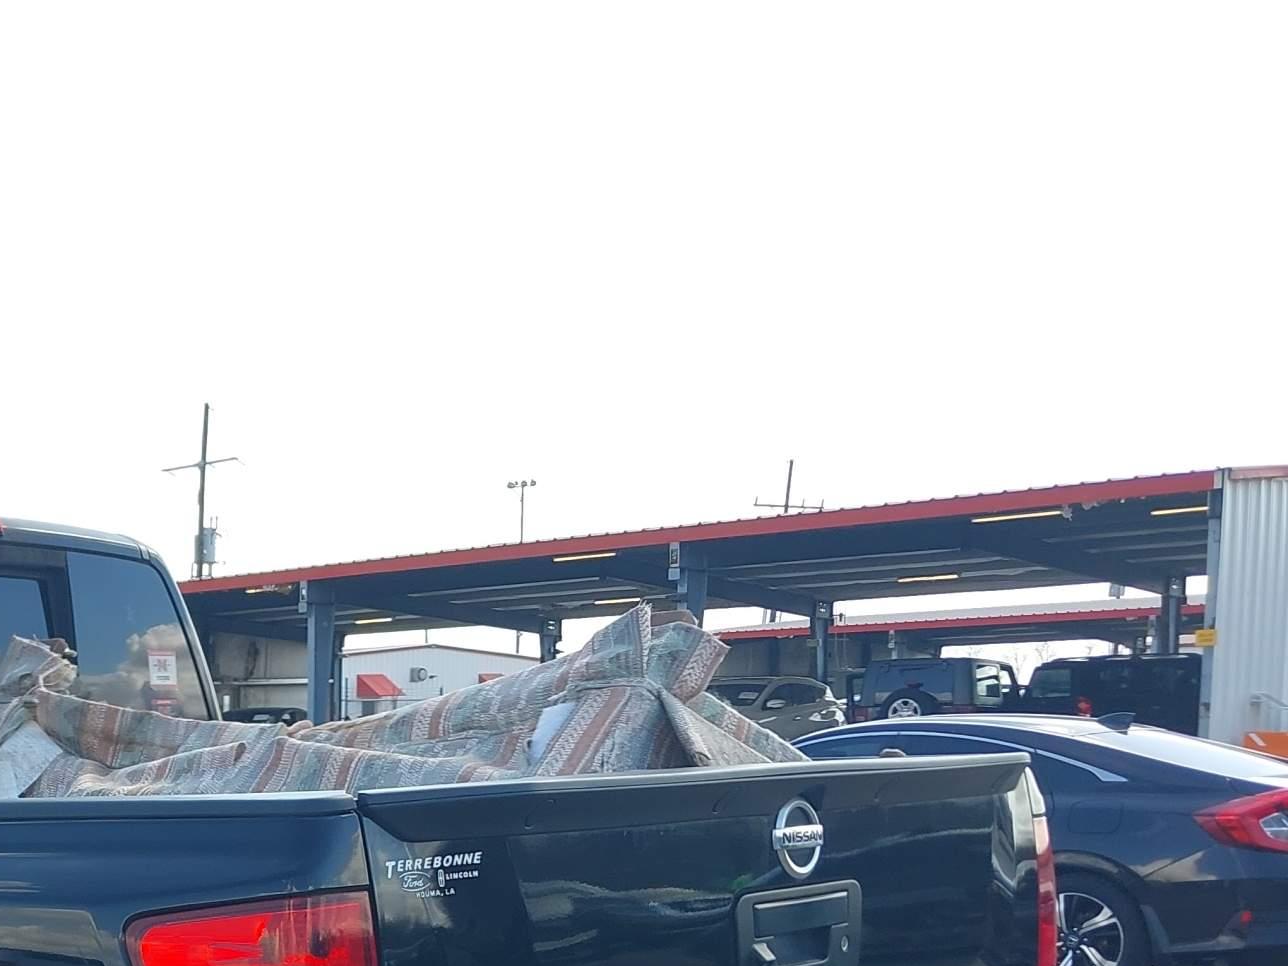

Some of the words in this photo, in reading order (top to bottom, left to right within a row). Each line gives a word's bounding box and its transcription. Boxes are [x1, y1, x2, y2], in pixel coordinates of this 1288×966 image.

[782, 829, 823, 845] NISSAN
[385, 851, 483, 879] TERREBONNE
[445, 870, 479, 881] LINCOLN
